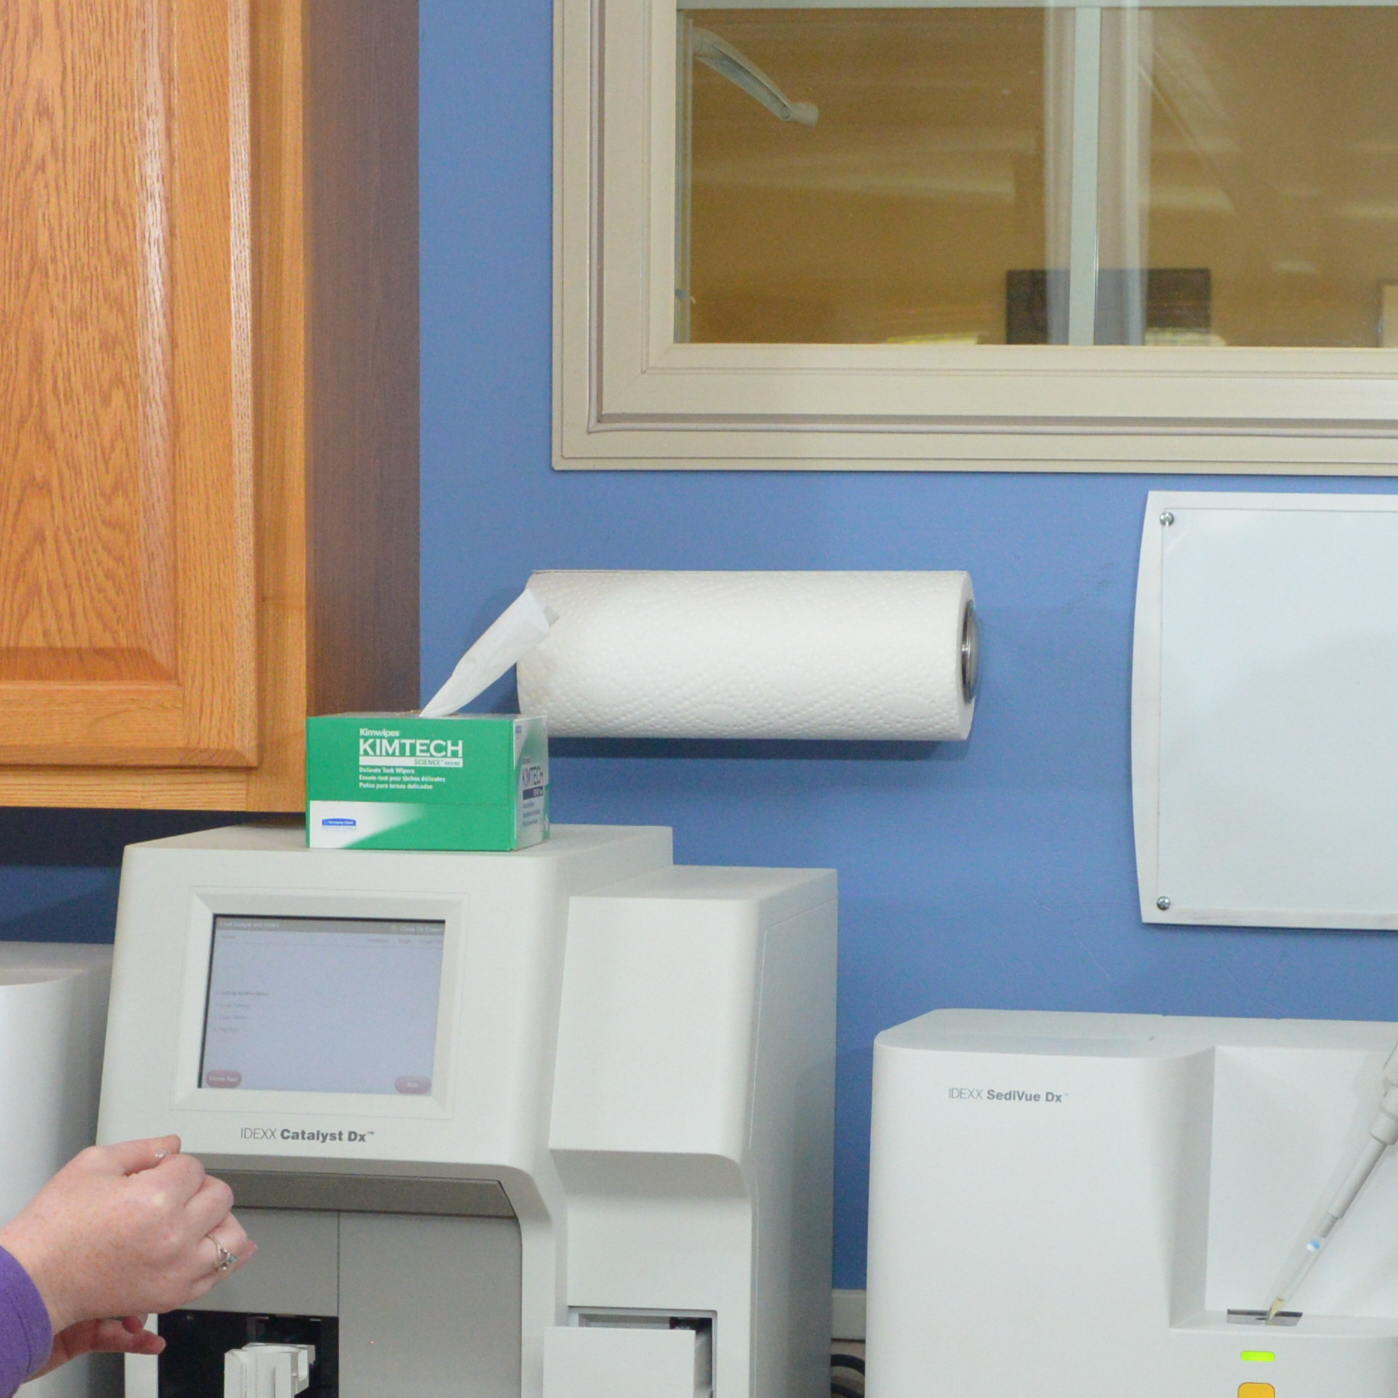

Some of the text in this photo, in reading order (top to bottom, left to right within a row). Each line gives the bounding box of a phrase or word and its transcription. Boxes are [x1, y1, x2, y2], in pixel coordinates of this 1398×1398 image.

[359, 738, 463, 758] KIMTECH
[949, 1088, 983, 1099] IDEXX
[987, 1089, 1041, 1102] SediVue
[240, 1127, 277, 1140] IDEXX
[280, 1128, 343, 1144] Catalyst
